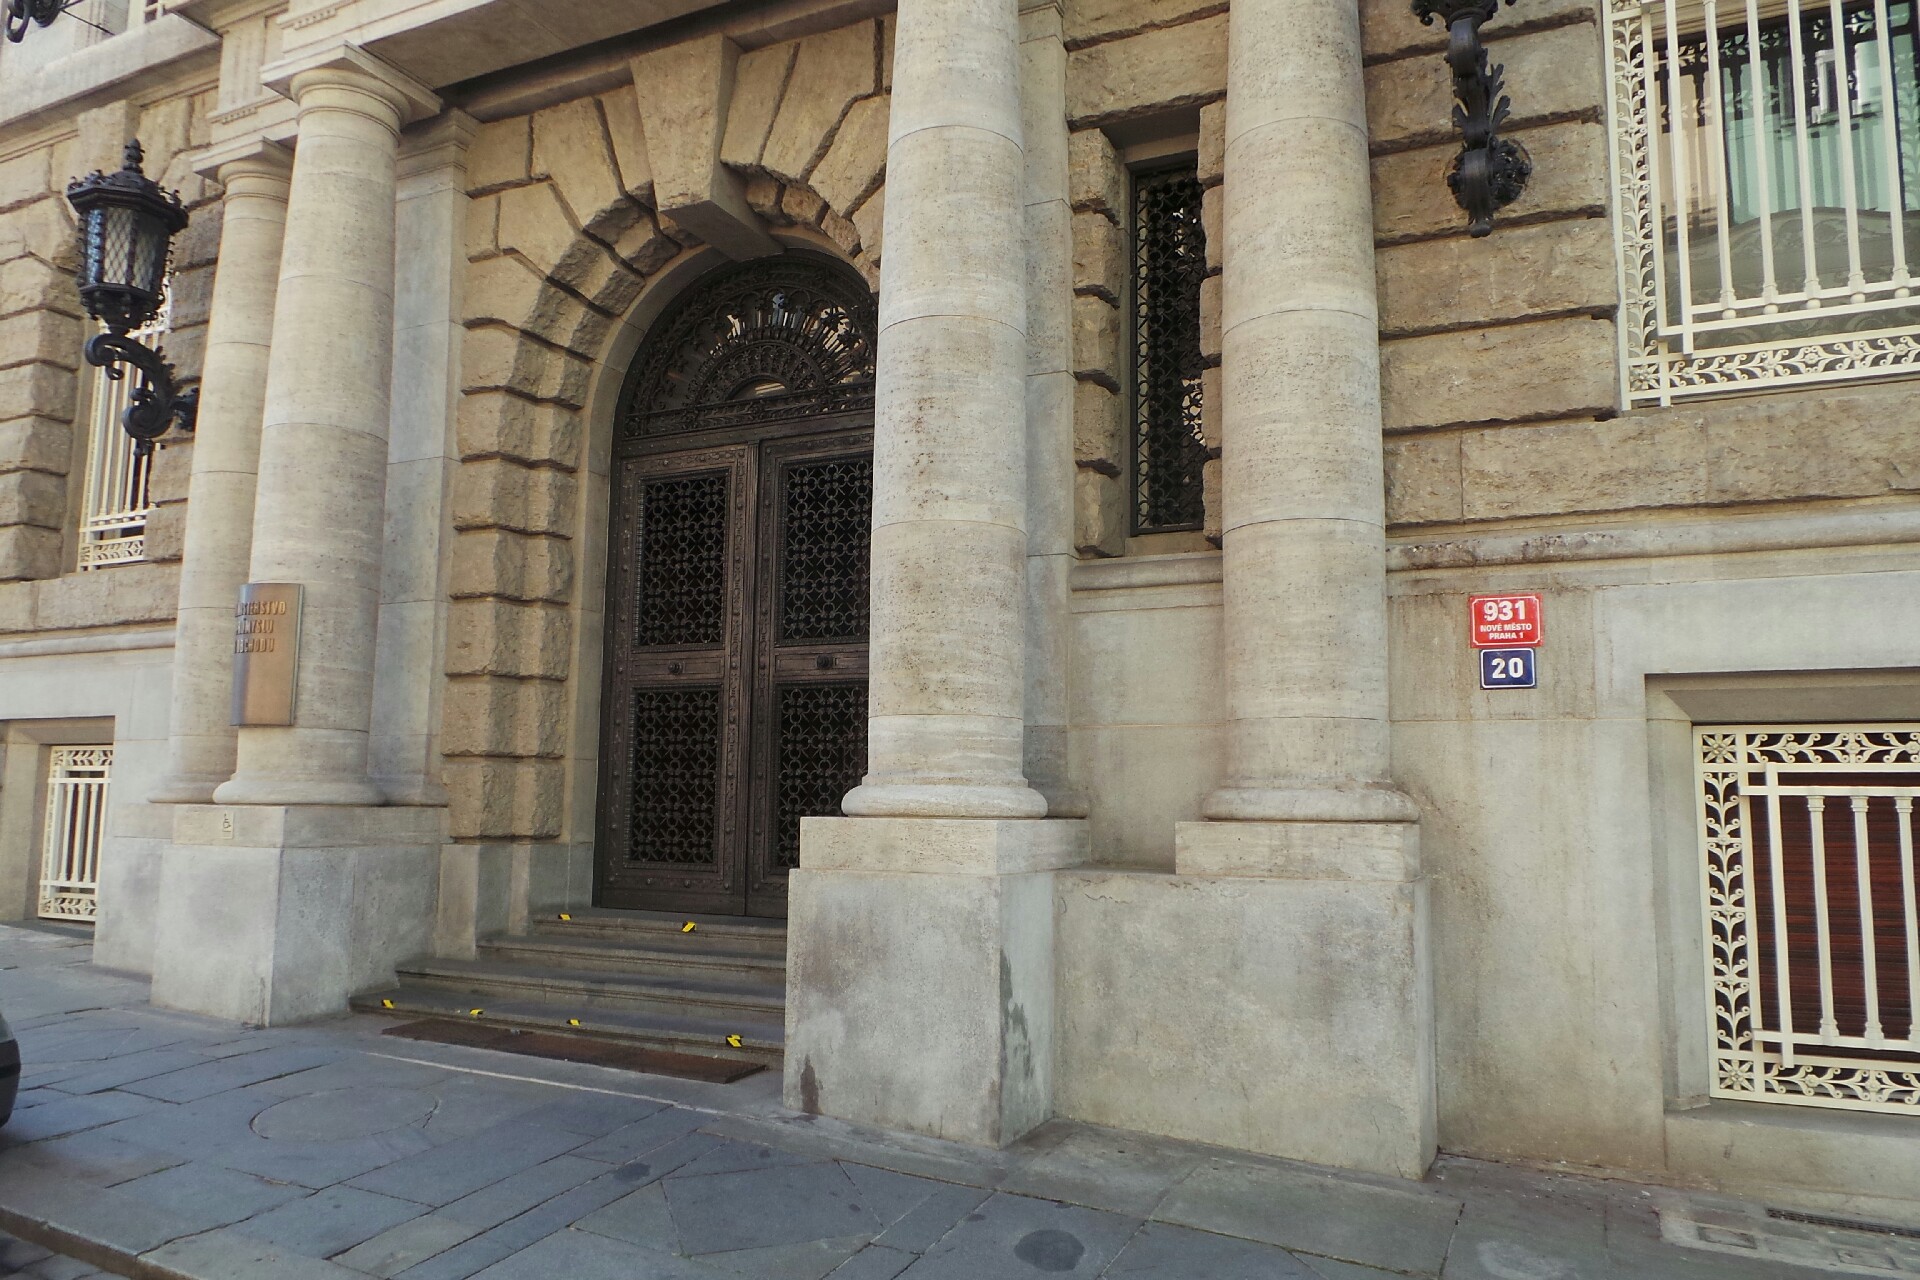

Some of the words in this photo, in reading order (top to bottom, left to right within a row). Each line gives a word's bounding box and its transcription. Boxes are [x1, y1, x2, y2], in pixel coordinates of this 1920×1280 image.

[1484, 600, 1526, 621] 931
[1480, 623, 1502, 632] NOVÉ
[1504, 622, 1532, 631] MĚSTO
[1489, 632, 1517, 640] PRAHA
[1491, 657, 1524, 679] 20
